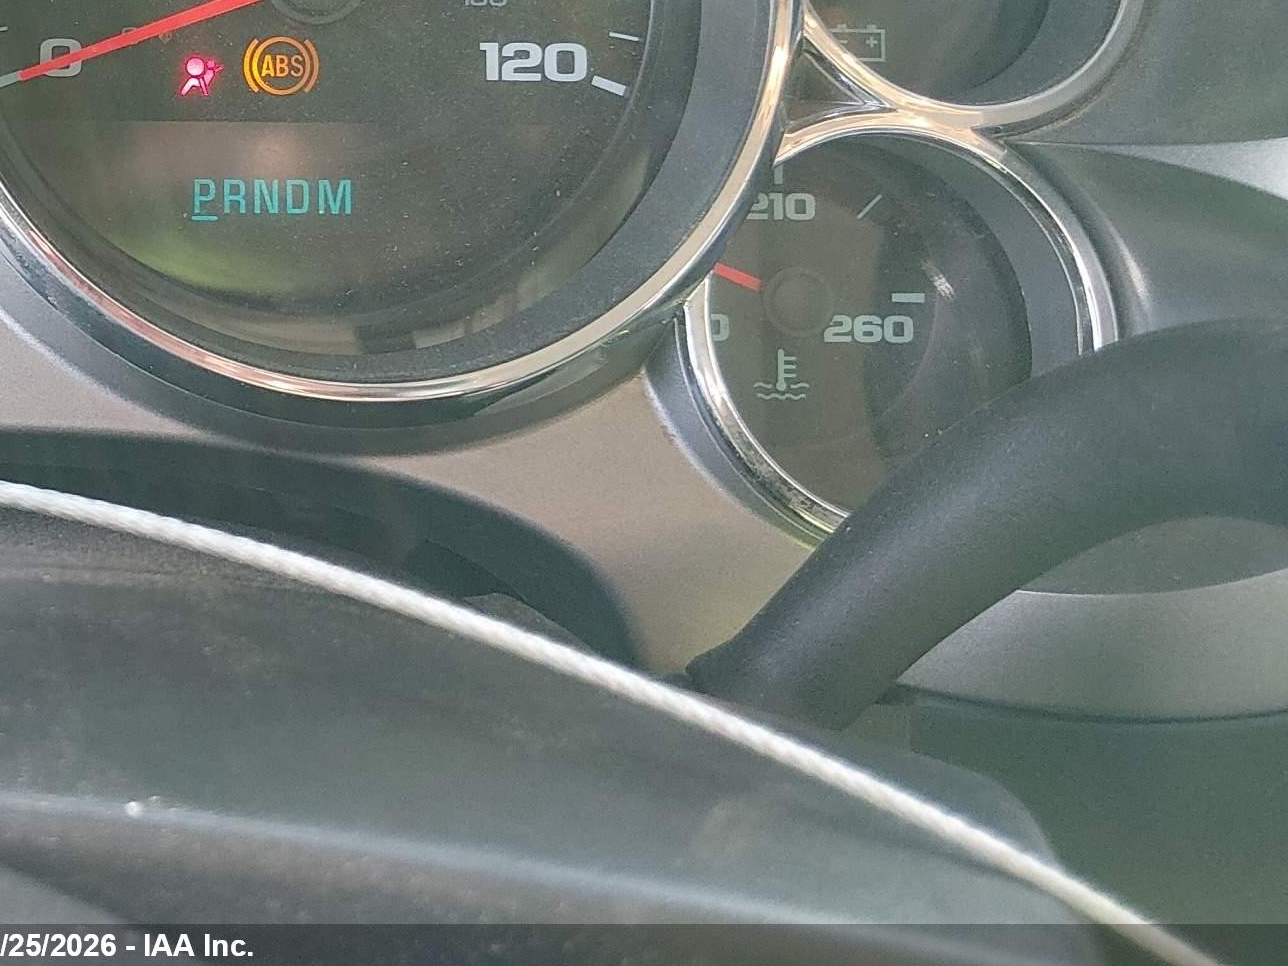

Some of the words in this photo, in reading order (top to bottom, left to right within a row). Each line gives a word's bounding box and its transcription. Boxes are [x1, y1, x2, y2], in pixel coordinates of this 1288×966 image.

[40, 38, 82, 77] 0
[261, 55, 304, 77] ABS
[479, 42, 587, 81] 120
[193, 178, 352, 216] PRNDM
[823, 314, 914, 343] 260
